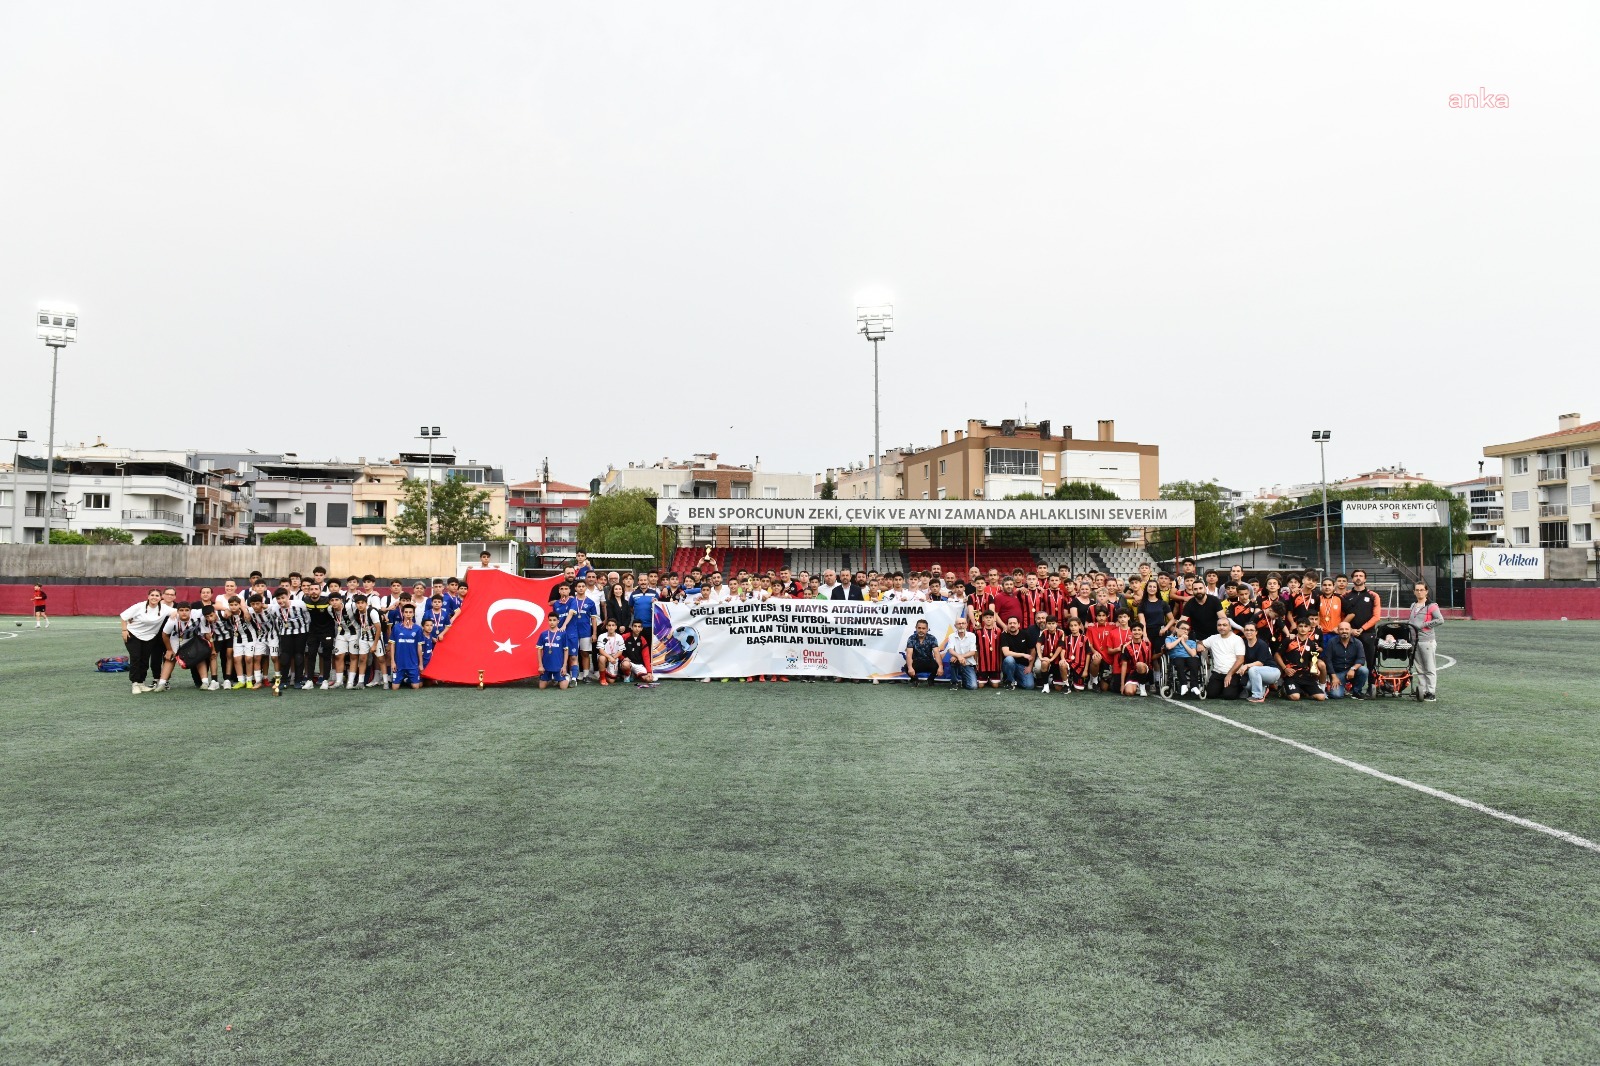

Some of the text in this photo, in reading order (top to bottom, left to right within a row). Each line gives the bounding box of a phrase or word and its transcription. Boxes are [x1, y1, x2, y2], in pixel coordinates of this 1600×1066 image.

[1346, 503, 1378, 511] AVRUPA
[1379, 503, 1401, 511] SPOR
[688, 507, 715, 520] BEN
[718, 507, 805, 520] SPORCUNUN
[808, 505, 842, 521] ZEKİ,
[845, 505, 886, 523] ÇEVİK
[888, 508, 906, 520] VE
[908, 508, 942, 520] AYNI
[944, 508, 1017, 520] ZAMANDA
[1019, 508, 1105, 520] AHLAKLISINI
[1108, 506, 1168, 520] SEVERİM
[1498, 553, 1539, 567] Pelikan
[780, 604, 792, 612] 19
[794, 604, 829, 613] MAYIS
[891, 606, 924, 615] ANMA
[751, 614, 789, 623] KUPASI
[791, 615, 831, 624] FUTBOL
[833, 616, 908, 626] TURNUVASINA
[729, 625, 773, 635] KATILAN
[775, 624, 799, 634] TÜM
[746, 635, 804, 645] BAŞARILAR
[802, 649, 825, 657] Onur
